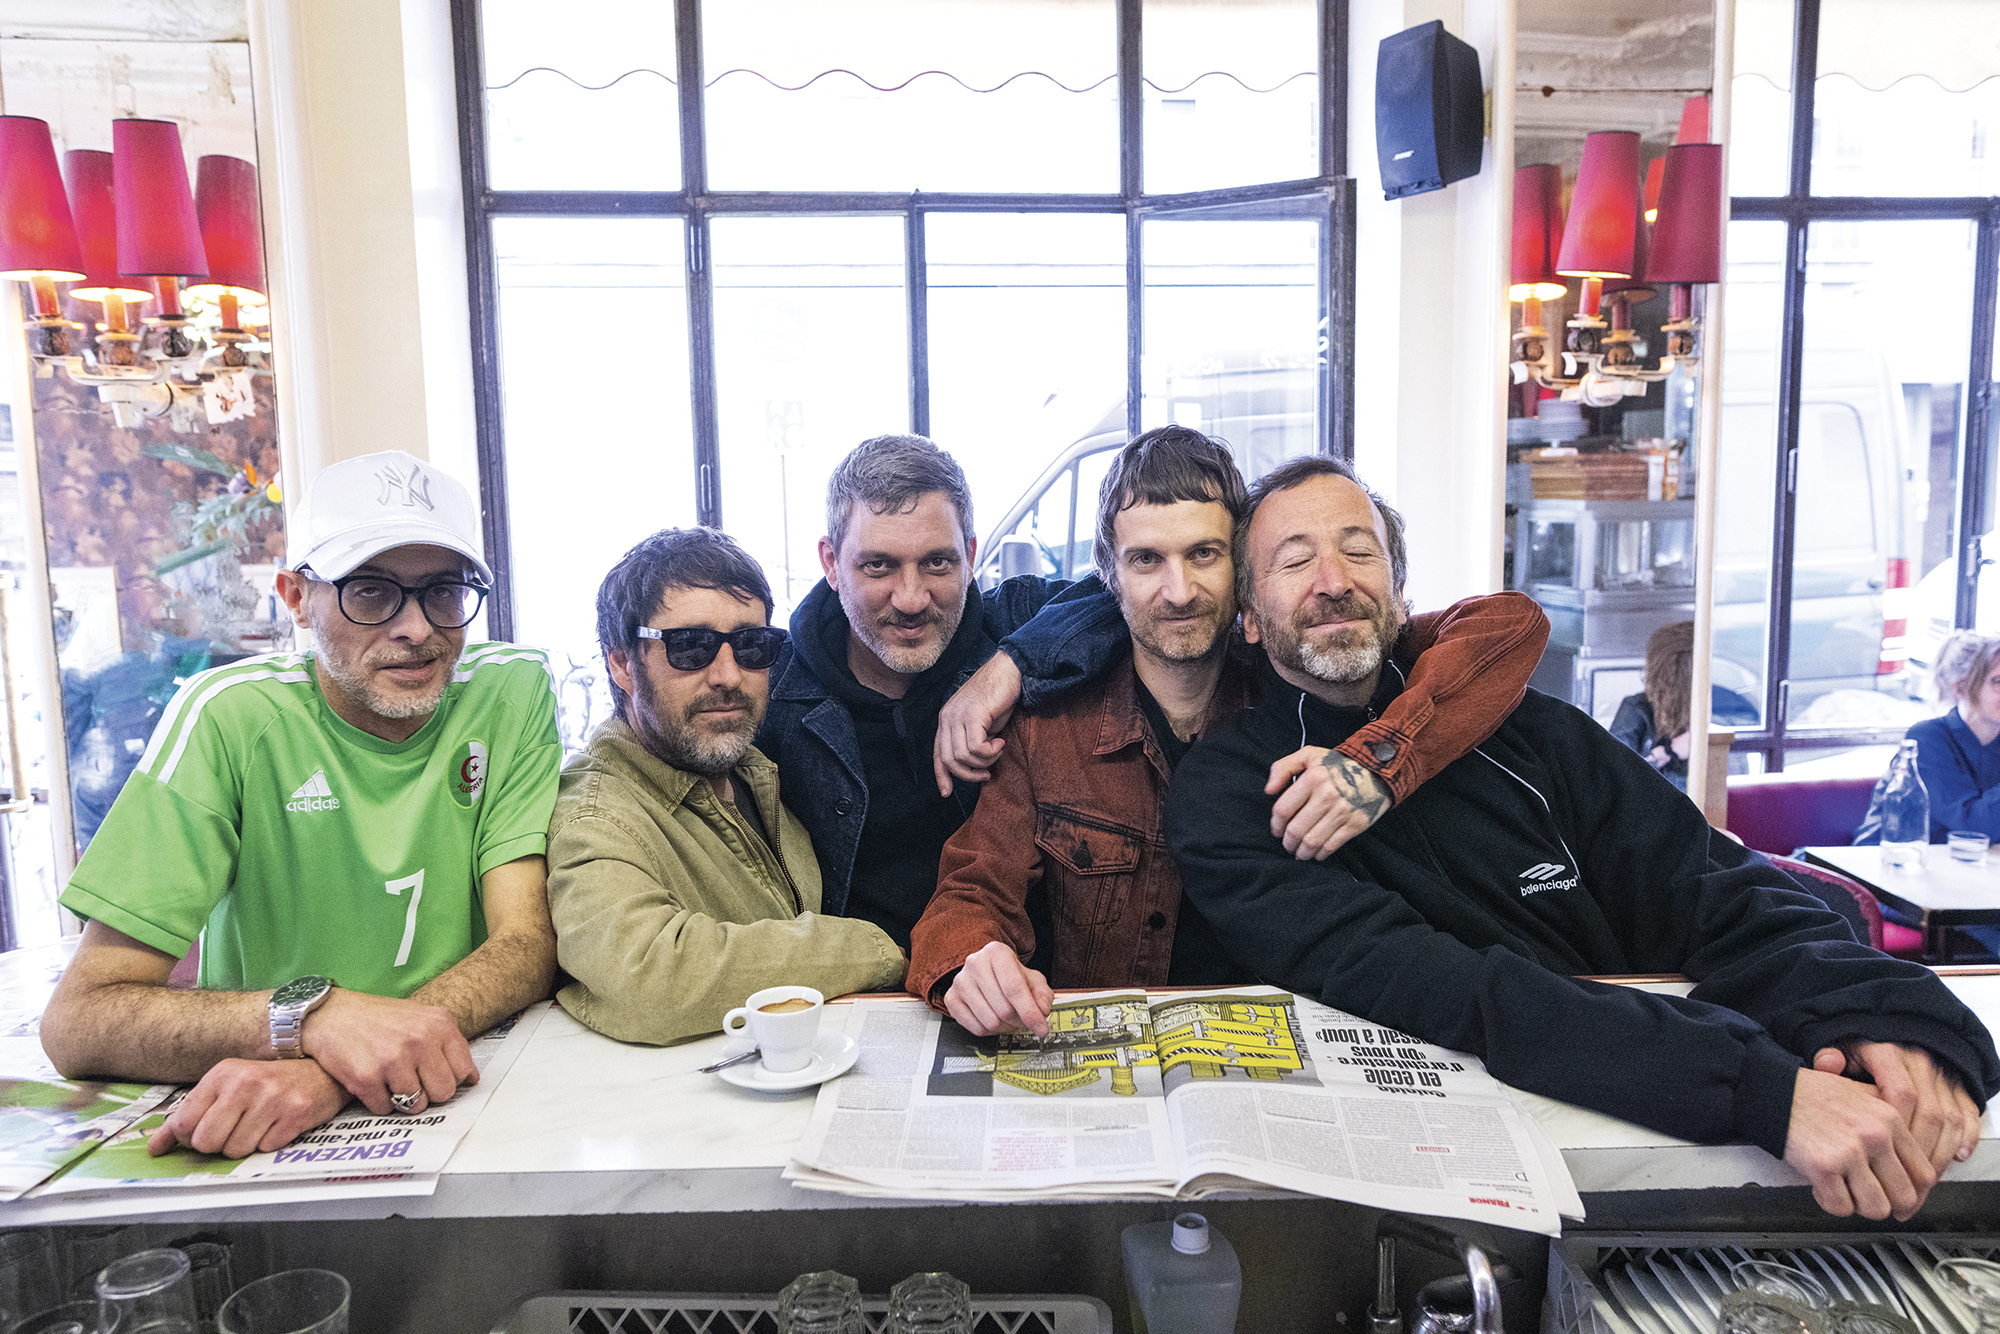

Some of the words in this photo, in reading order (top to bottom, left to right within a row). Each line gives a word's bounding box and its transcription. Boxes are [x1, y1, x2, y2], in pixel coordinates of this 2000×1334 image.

[374, 459, 435, 512] NY
[286, 797, 340, 813] adidas
[1520, 878, 1577, 897] balenciaga
[385, 868, 425, 967] 7
[1362, 1028, 1373, 1045] à
[1350, 1045, 1395, 1058] nous
[1364, 1069, 1415, 1087] école
[1417, 1071, 1442, 1087] en
[335, 1118, 373, 1131] une
[375, 1115, 447, 1126] devenu
[389, 1128, 413, 1138] Le
[272, 1140, 413, 1164] BENZEMA
